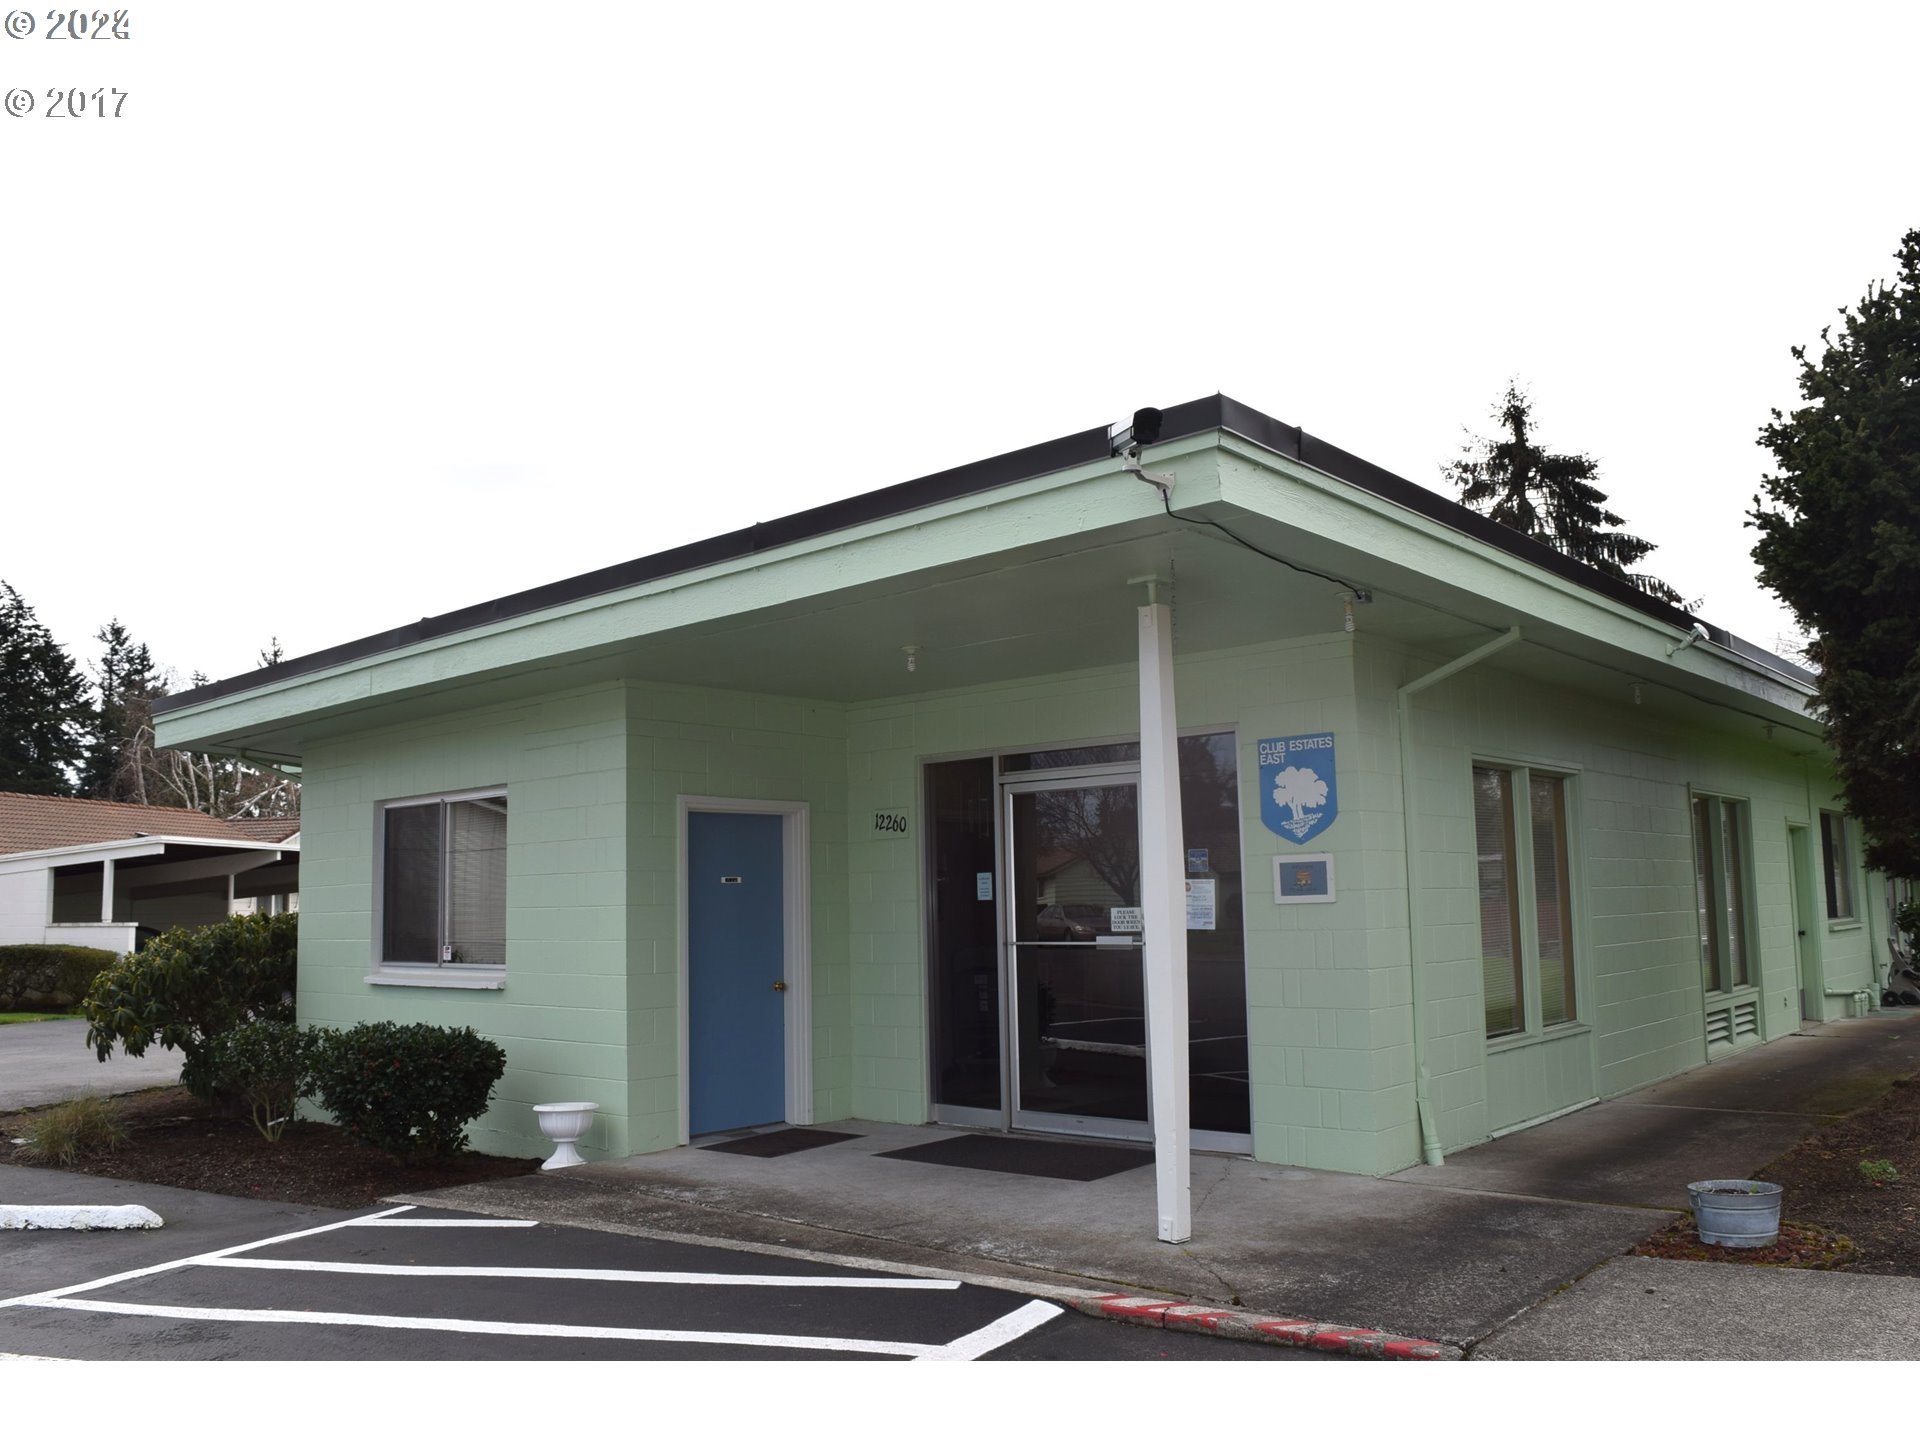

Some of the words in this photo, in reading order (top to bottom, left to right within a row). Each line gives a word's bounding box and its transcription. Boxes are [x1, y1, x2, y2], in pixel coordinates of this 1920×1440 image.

[1260, 741, 1286, 754] CLUB
[1289, 736, 1333, 751] ESTATES
[1260, 752, 1286, 765] EAST
[875, 813, 907, 832] 12260
